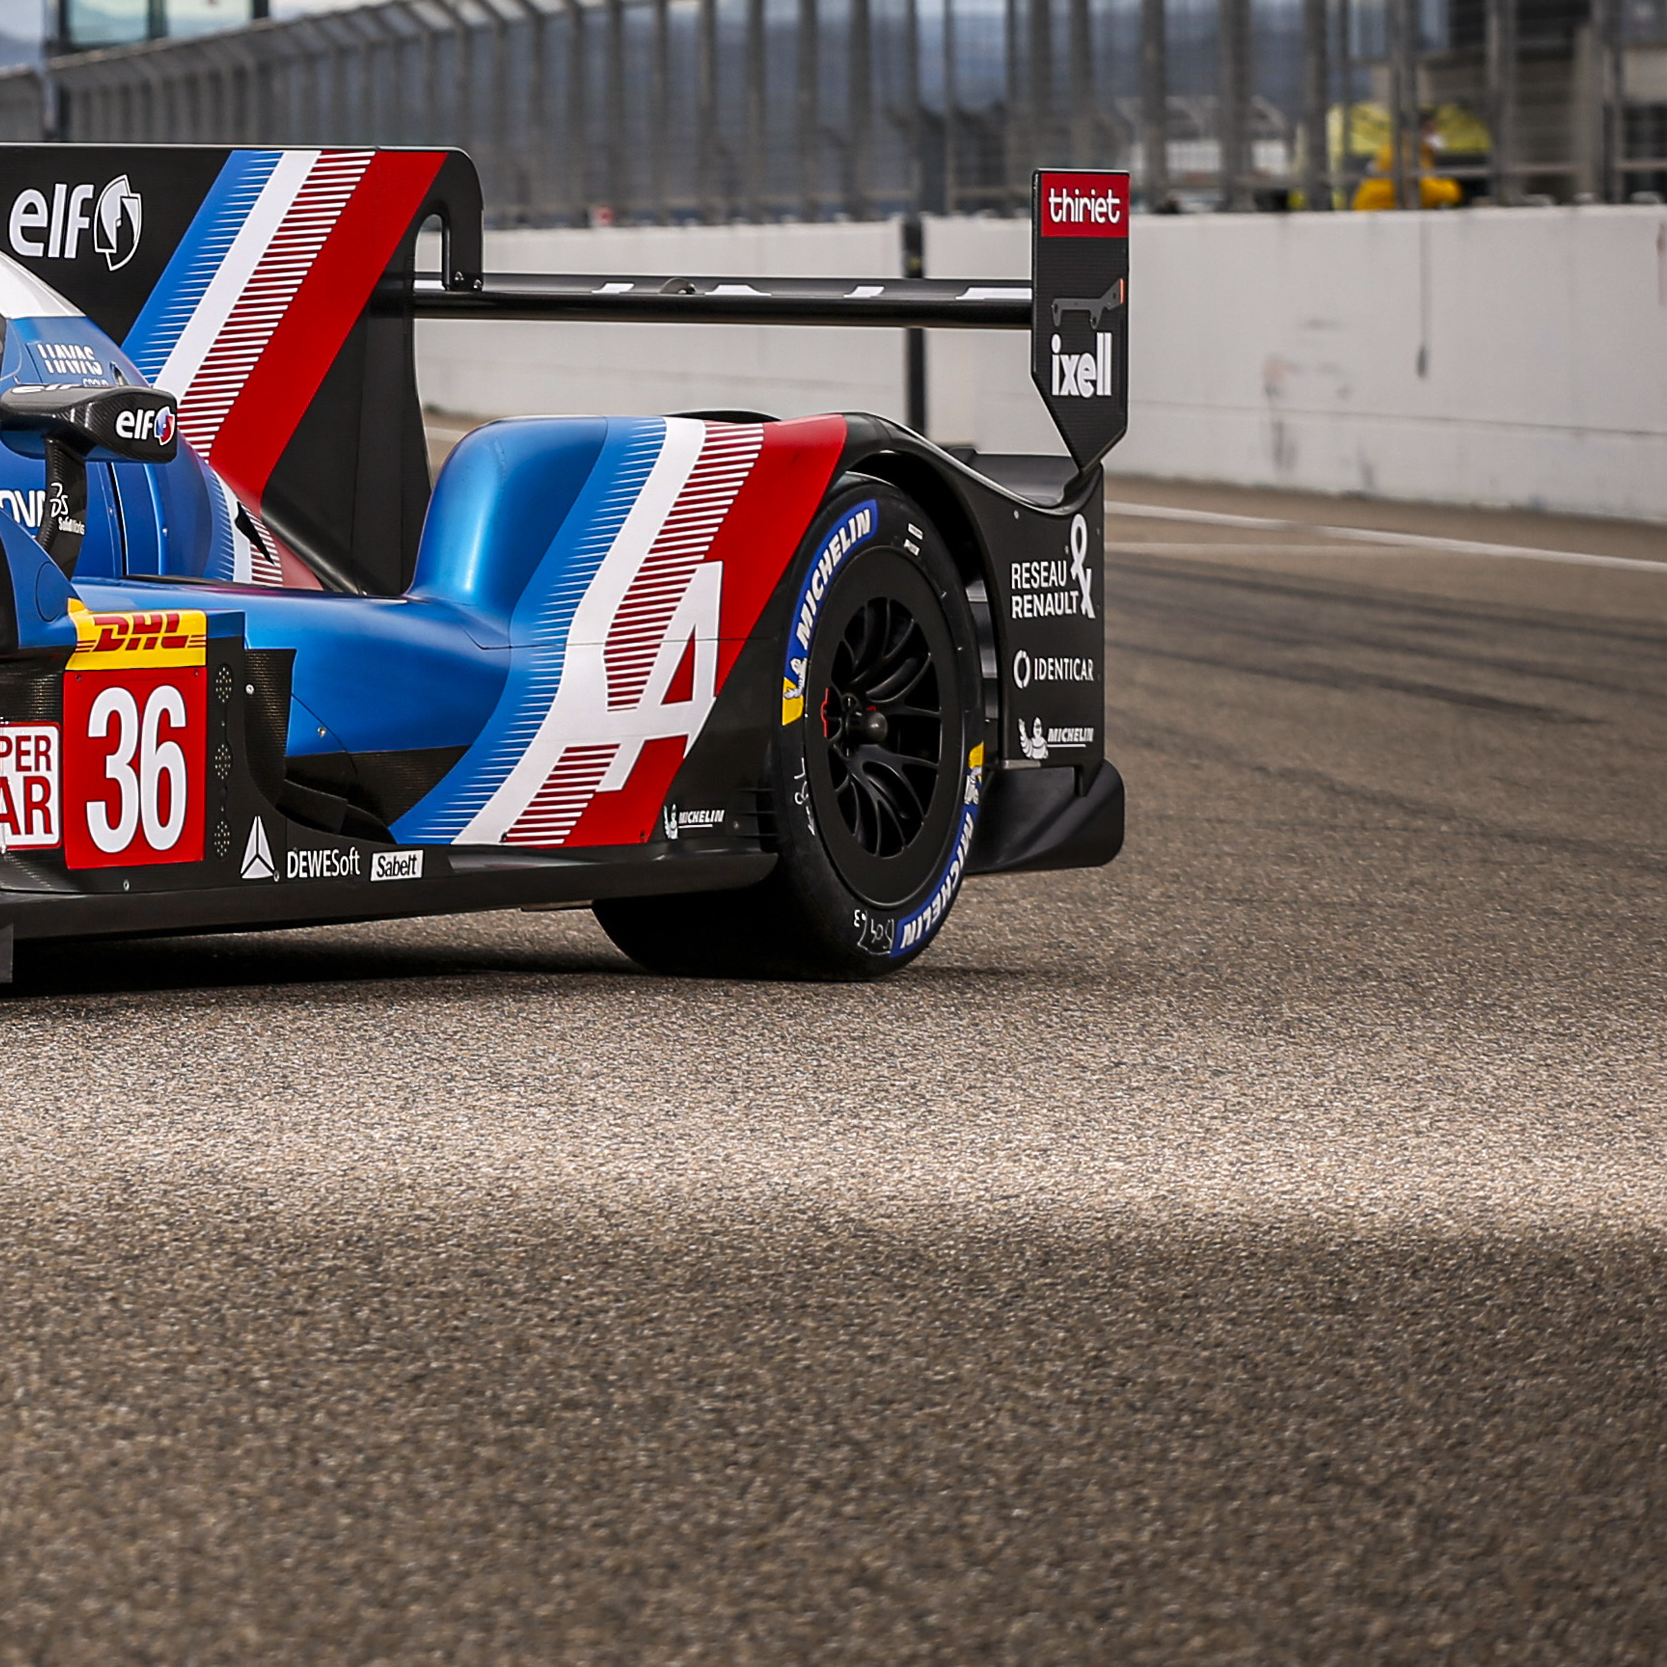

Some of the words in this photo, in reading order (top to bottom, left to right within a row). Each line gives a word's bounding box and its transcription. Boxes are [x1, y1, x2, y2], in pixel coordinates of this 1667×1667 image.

[8, 182, 97, 259] elf
[1048, 188, 1121, 224] thiriet
[1051, 332, 1112, 398] ixell
[115, 408, 155, 440] elf
[794, 506, 873, 651] MICHELIN
[1011, 560, 1067, 590] RESEAU
[1011, 591, 1079, 619] RENAULT
[92, 613, 191, 652] DHL
[1034, 658, 1094, 681] IDENTICAR
[1047, 727, 1094, 743] MICHELIN
[86, 685, 187, 854] 36
[286, 847, 361, 879] DEWESoft
[376, 855, 419, 878] Sabelt
